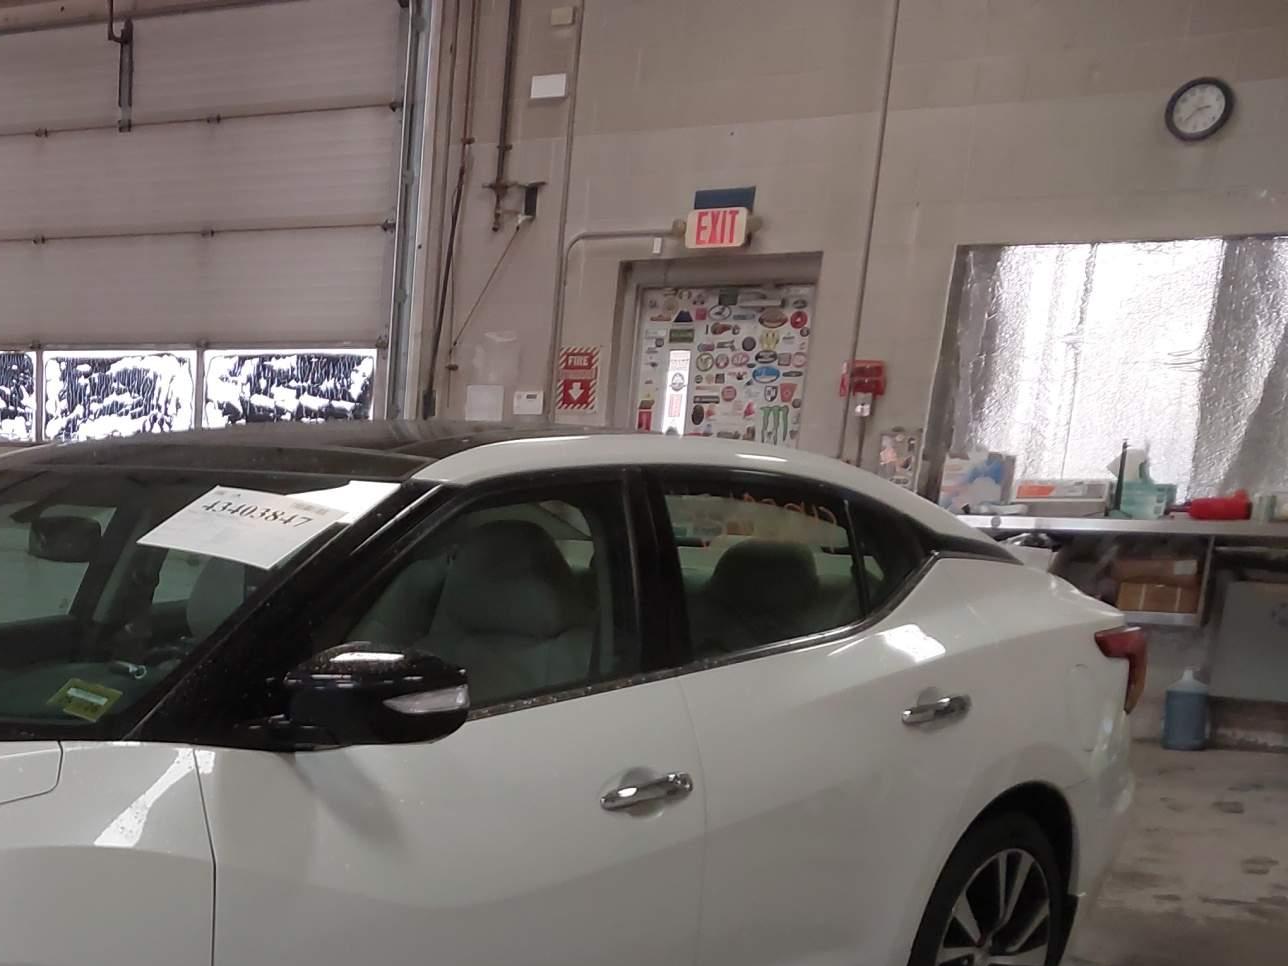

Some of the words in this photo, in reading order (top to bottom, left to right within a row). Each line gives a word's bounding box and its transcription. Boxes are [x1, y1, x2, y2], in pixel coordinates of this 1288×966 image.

[695, 208, 740, 246] EXIT
[567, 355, 590, 367] FIRE
[202, 501, 313, 527] 43403847
